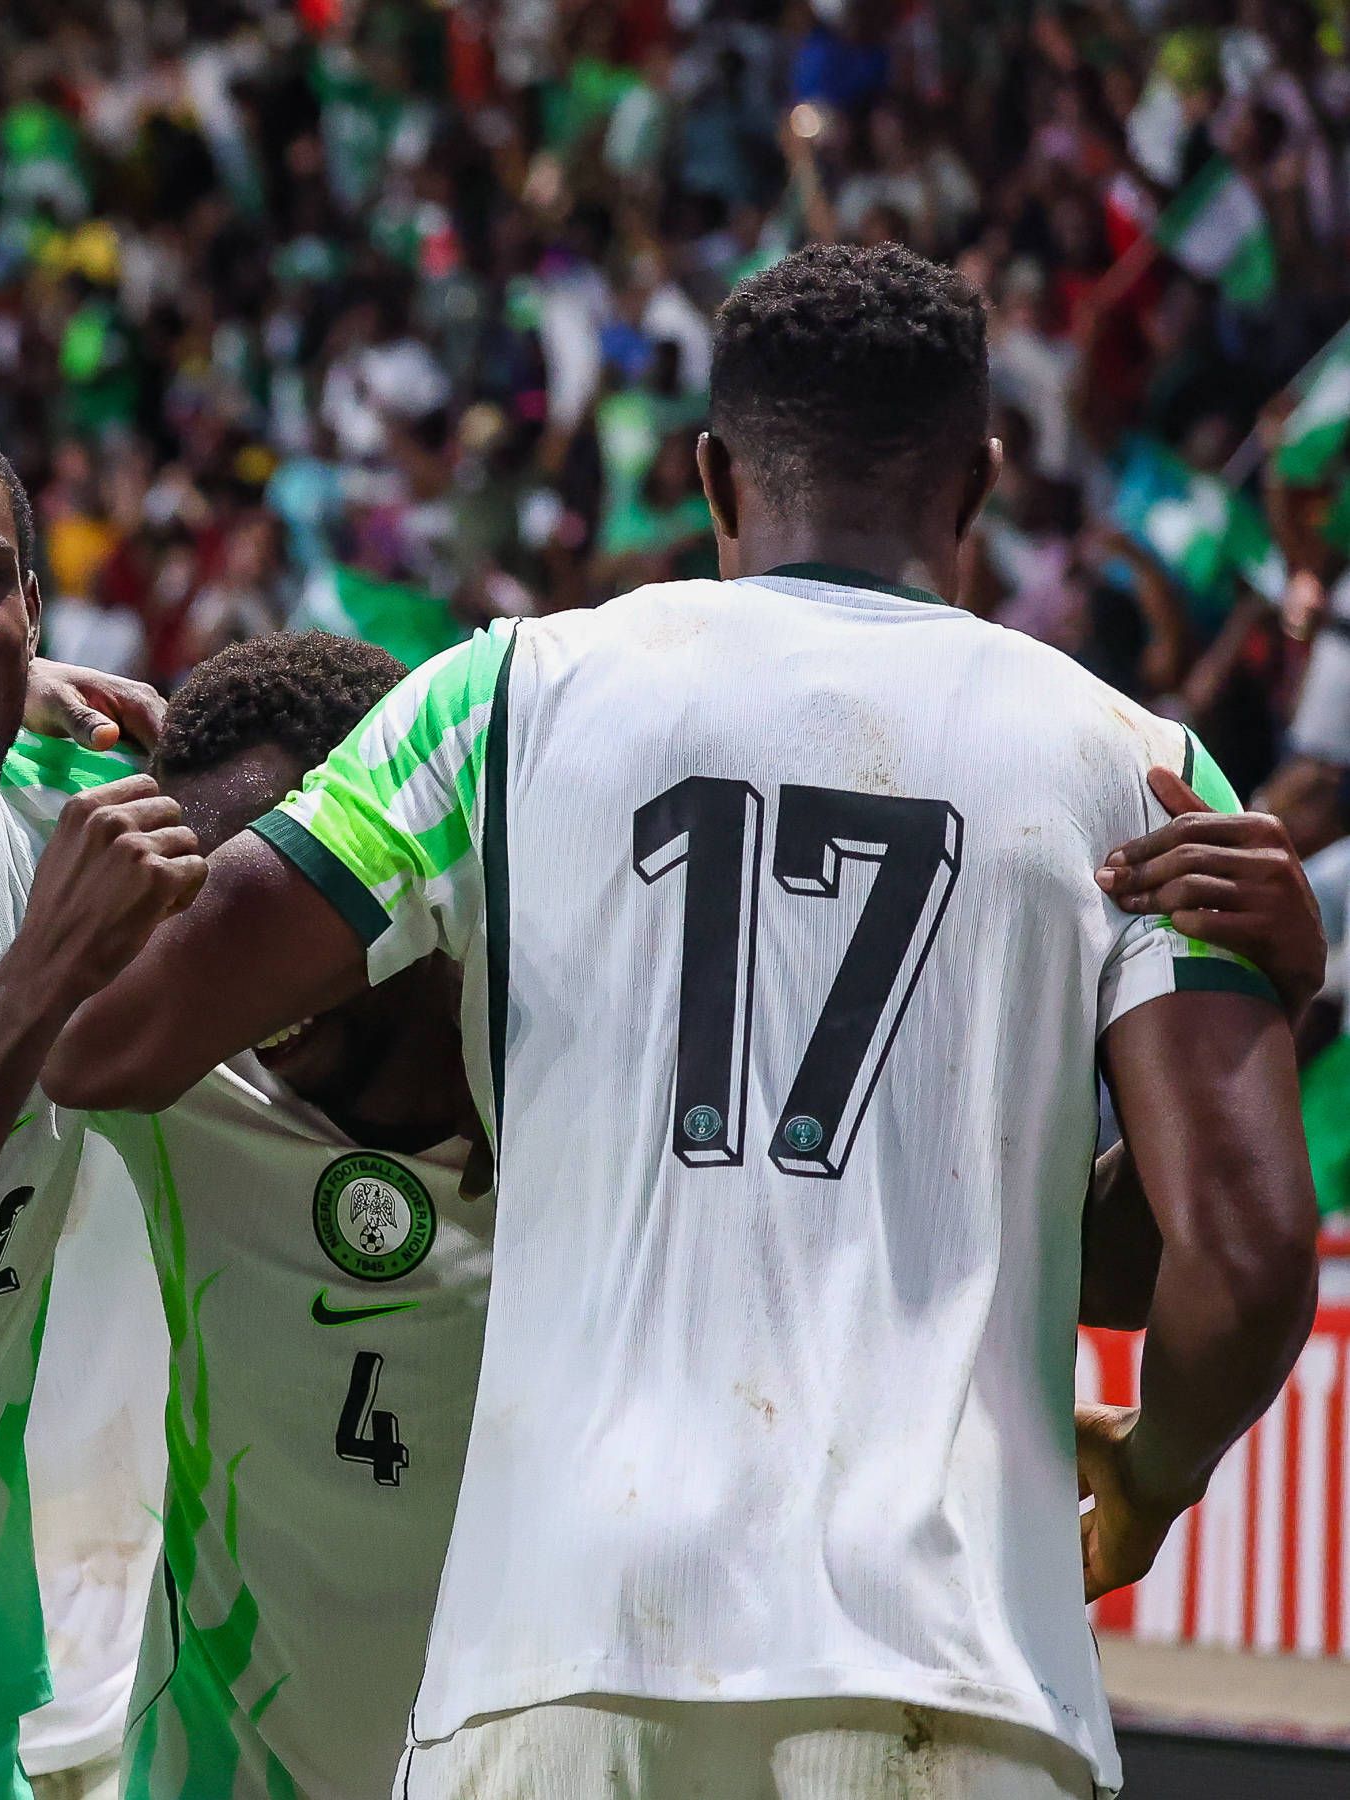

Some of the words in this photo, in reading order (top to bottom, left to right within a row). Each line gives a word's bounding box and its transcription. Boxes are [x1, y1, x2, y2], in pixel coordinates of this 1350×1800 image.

[633, 776, 964, 1180] 17
[327, 1160, 394, 1188] FOOTBALL
[396, 1174, 429, 1263] FEDERATION
[319, 1189, 340, 1249] NIGERIA
[336, 1351, 409, 1486] 4
